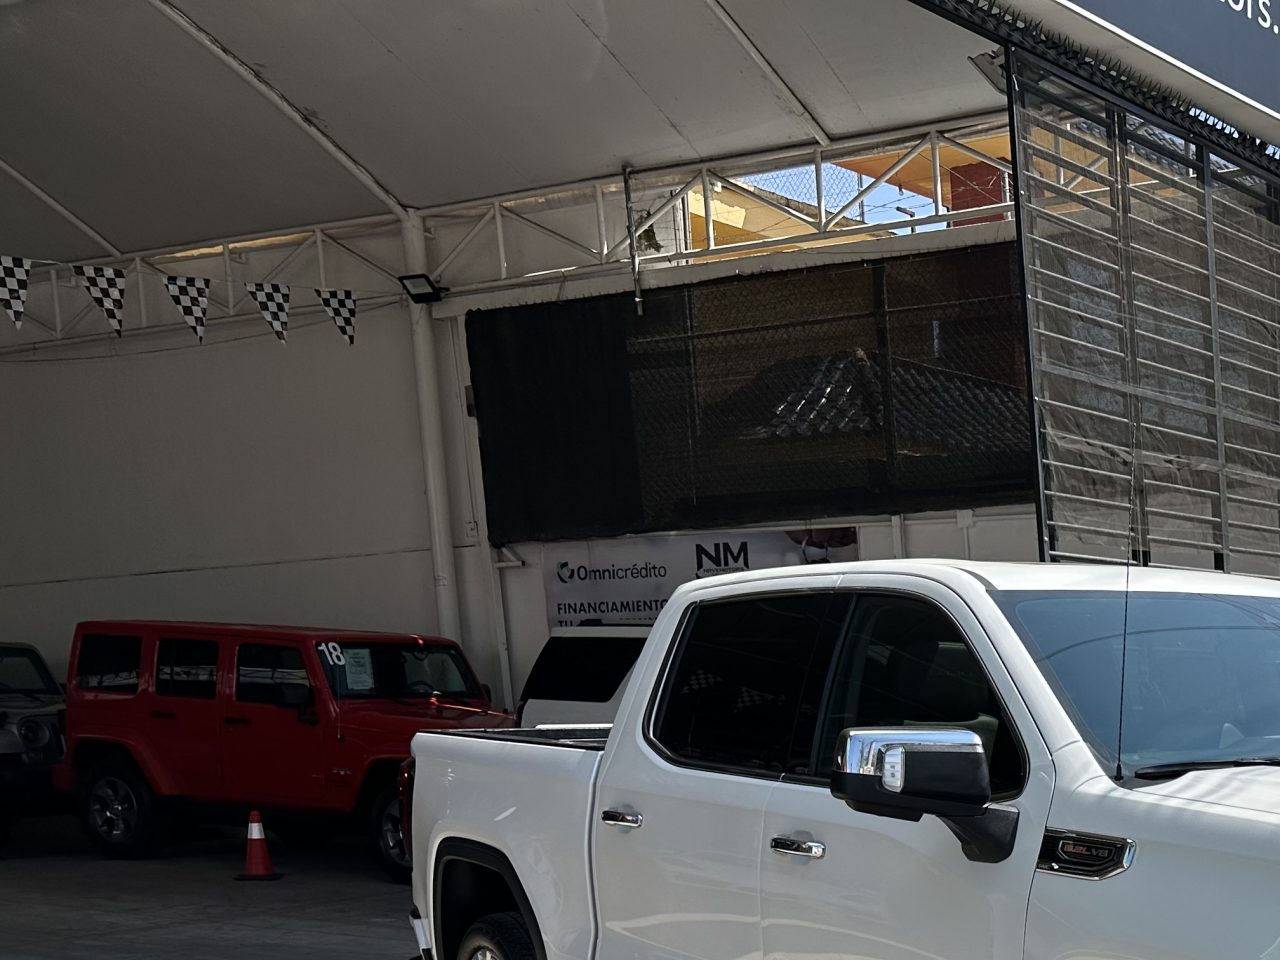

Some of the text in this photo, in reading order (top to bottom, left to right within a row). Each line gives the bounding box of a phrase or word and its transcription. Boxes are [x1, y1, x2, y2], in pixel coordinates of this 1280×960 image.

[695, 541, 749, 569] NM
[577, 562, 667, 581] Omnicrédito
[318, 641, 346, 666] 18
